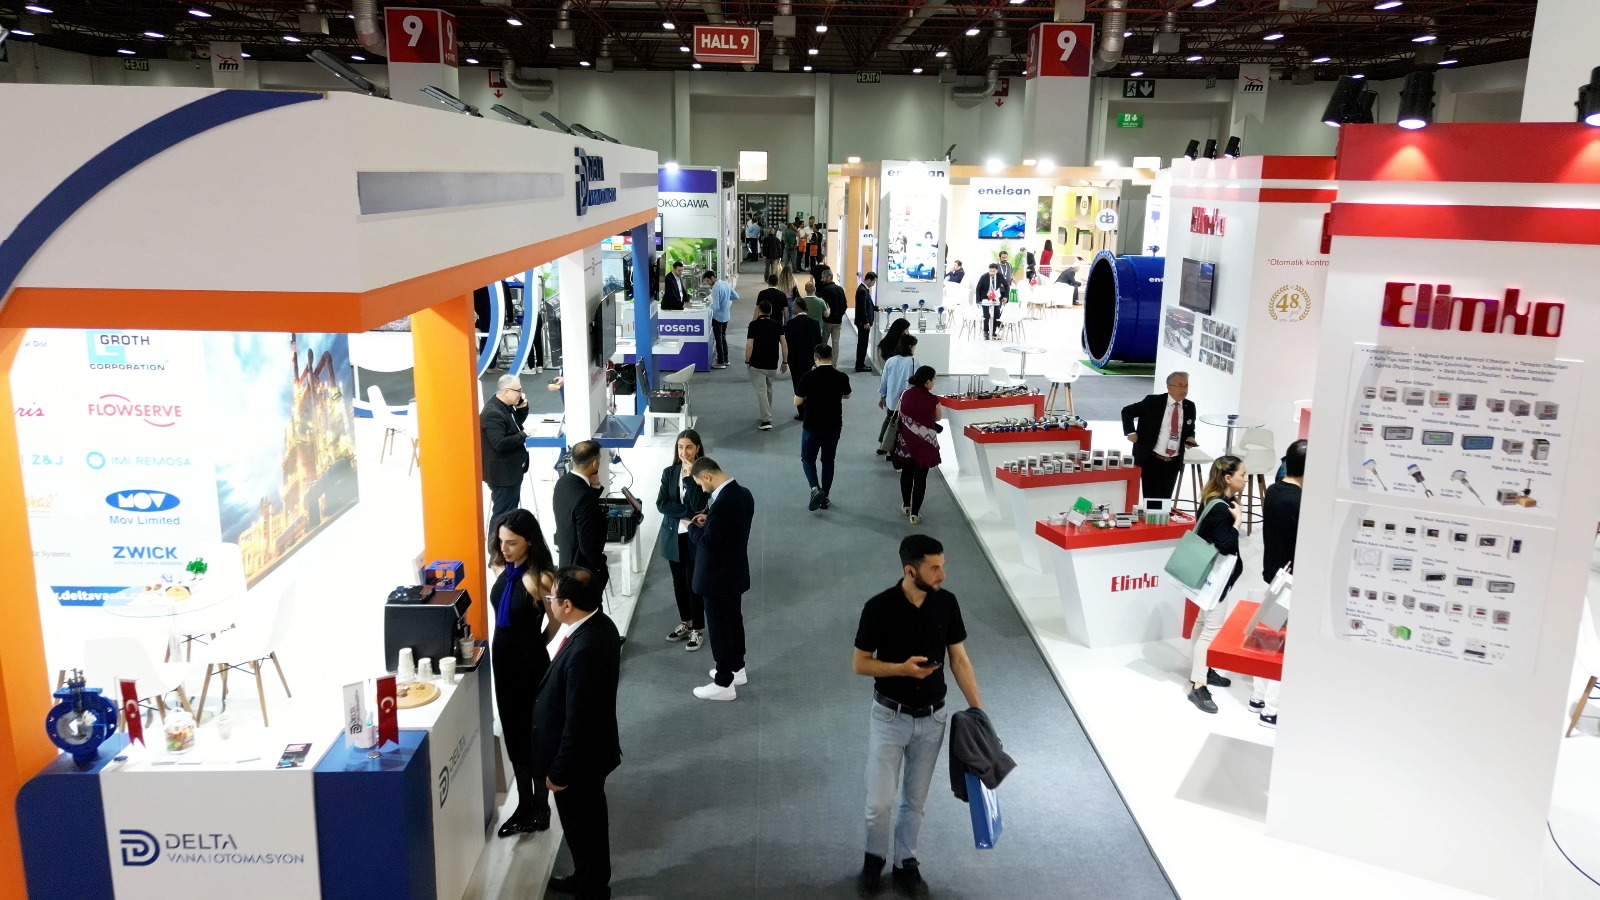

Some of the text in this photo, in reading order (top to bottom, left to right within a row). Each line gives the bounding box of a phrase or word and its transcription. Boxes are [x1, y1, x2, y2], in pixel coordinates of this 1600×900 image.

[402, 15, 424, 47] 9
[446, 20, 454, 50] 9
[701, 33, 750, 50] HALL 9
[1056, 30, 1077, 62] 9
[130, 60, 148, 71] EXIT
[862, 72, 876, 82] EXIT
[978, 184, 1031, 195] enelsan
[1100, 212, 1115, 224] da
[1380, 281, 1565, 338] Elimko
[658, 323, 700, 332] rosens
[100, 334, 150, 345] GROTH
[88, 403, 182, 418] FLOWSERVE
[32, 455, 63, 465] Z&J
[111, 457, 192, 466] IMI REMOSA
[117, 492, 167, 510] MOV
[110, 516, 180, 526] Mov Limited
[112, 546, 178, 559] ZWICK
[1111, 572, 1159, 592] Elimko
[165, 833, 238, 850] DELTA
